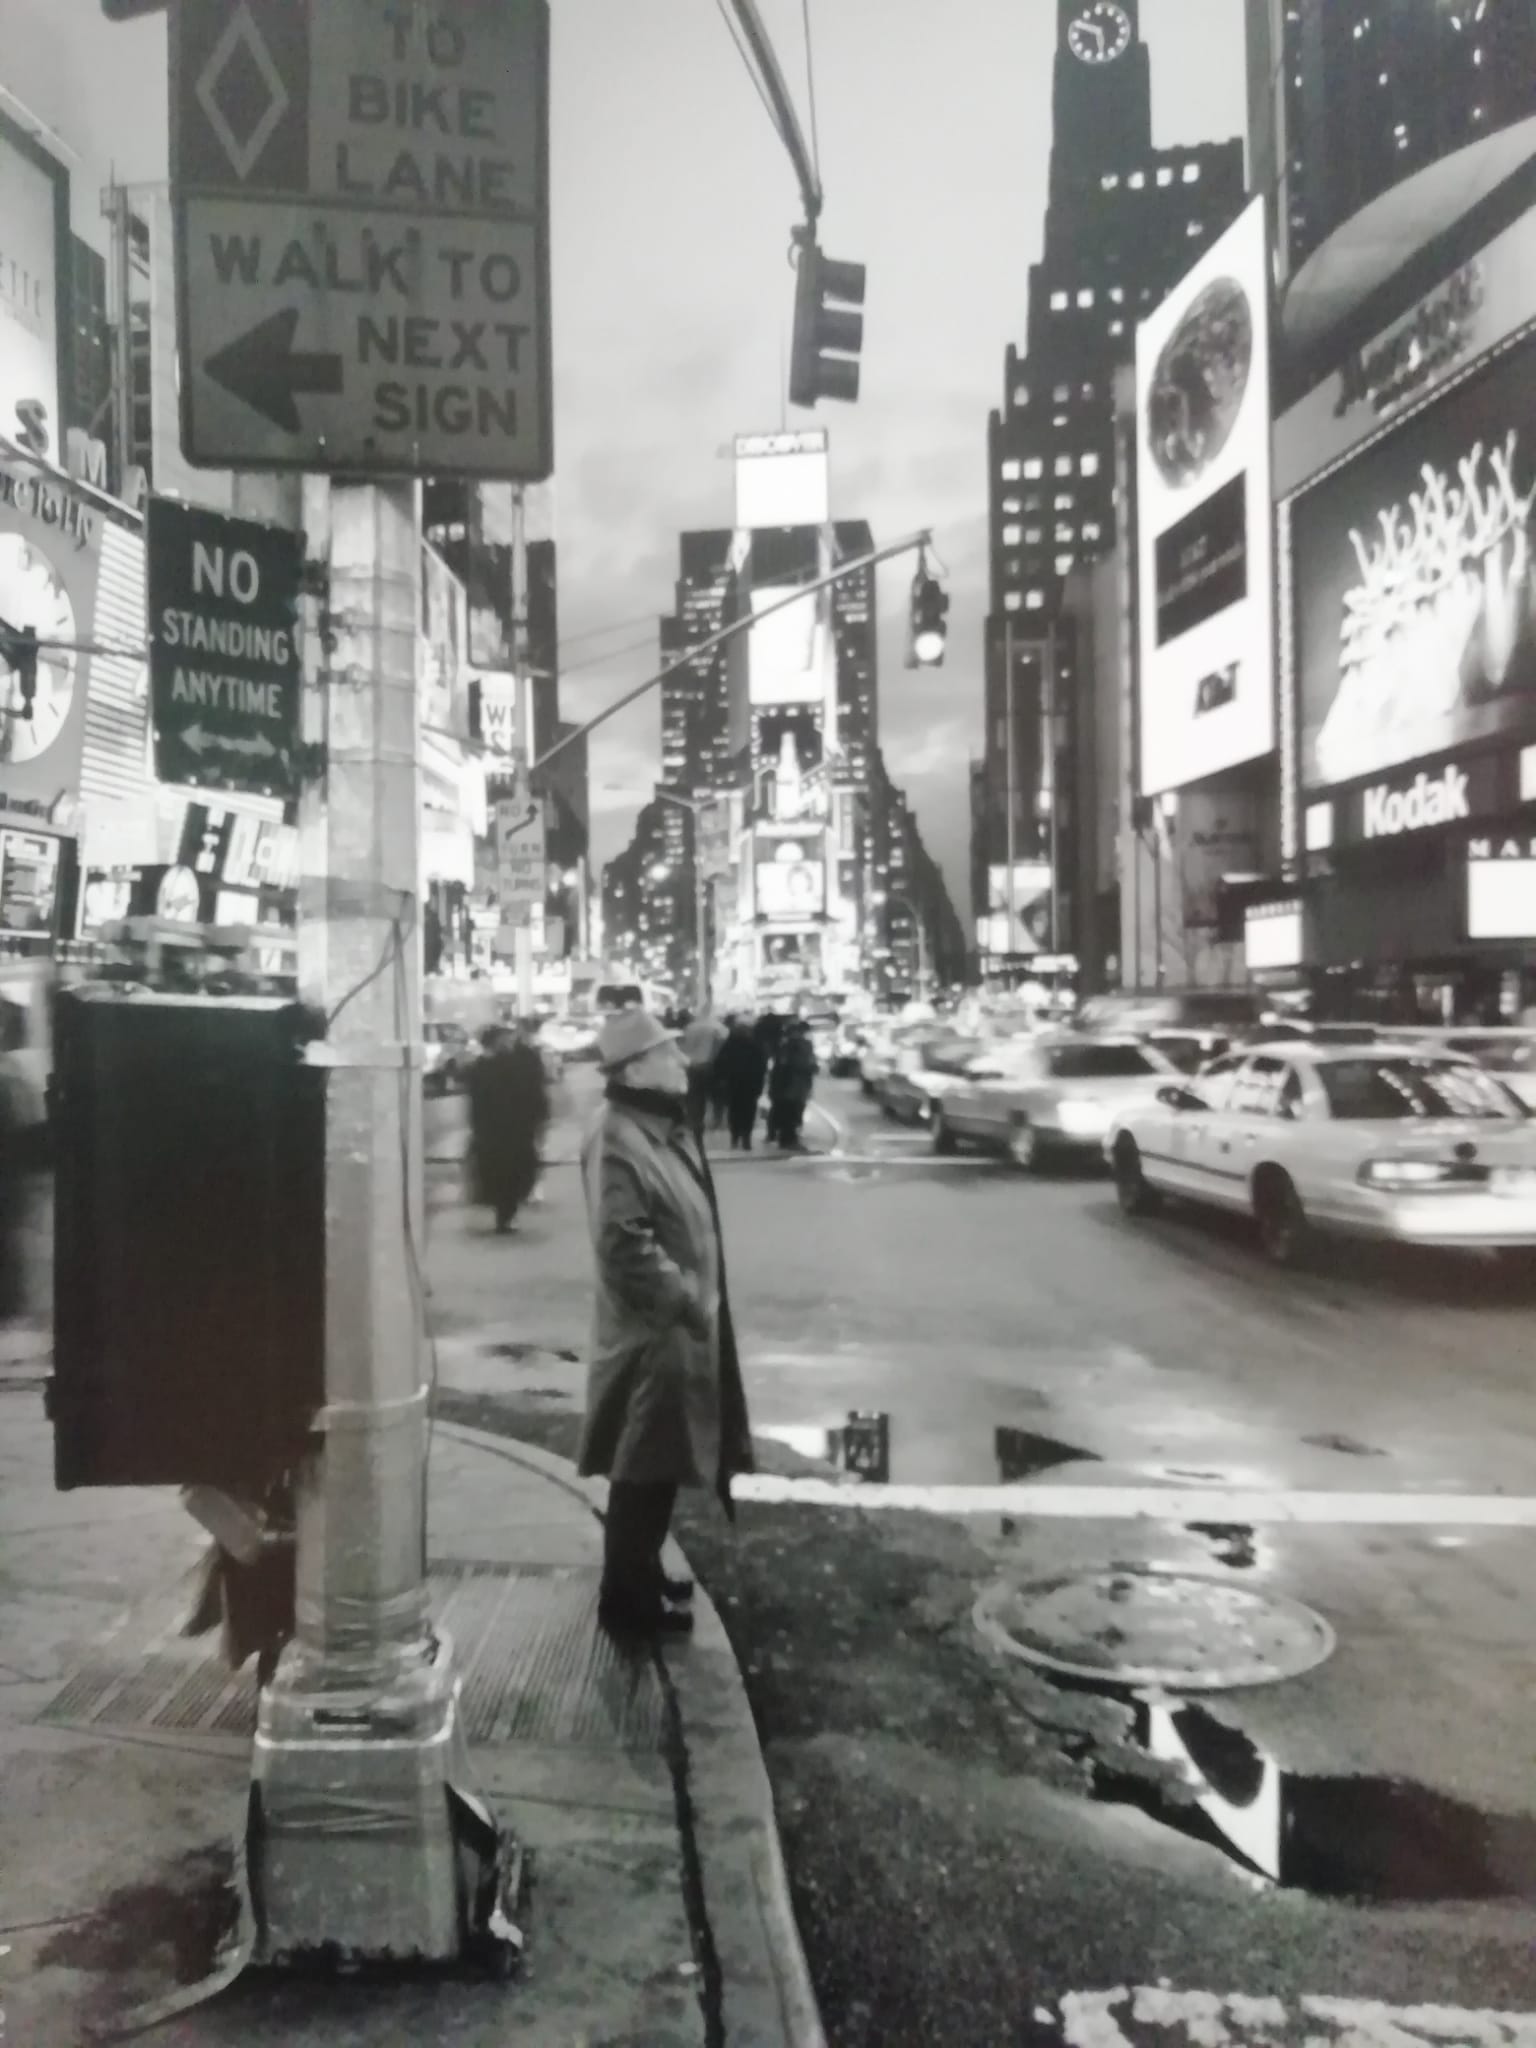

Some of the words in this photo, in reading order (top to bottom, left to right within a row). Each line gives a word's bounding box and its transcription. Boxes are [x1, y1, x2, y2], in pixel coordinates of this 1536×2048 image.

[381, 8, 467, 68] TO
[348, 74, 497, 140] BIKE
[336, 143, 516, 205] LANE
[209, 232, 408, 296] WALK
[437, 246, 521, 303] TO
[357, 315, 530, 373] NEXT
[373, 381, 518, 438] SIGN
[192, 540, 260, 604] NO
[162, 607, 289, 666] STANDING
[172, 666, 283, 718] ANYTIME
[1363, 764, 1470, 838] Kodak
